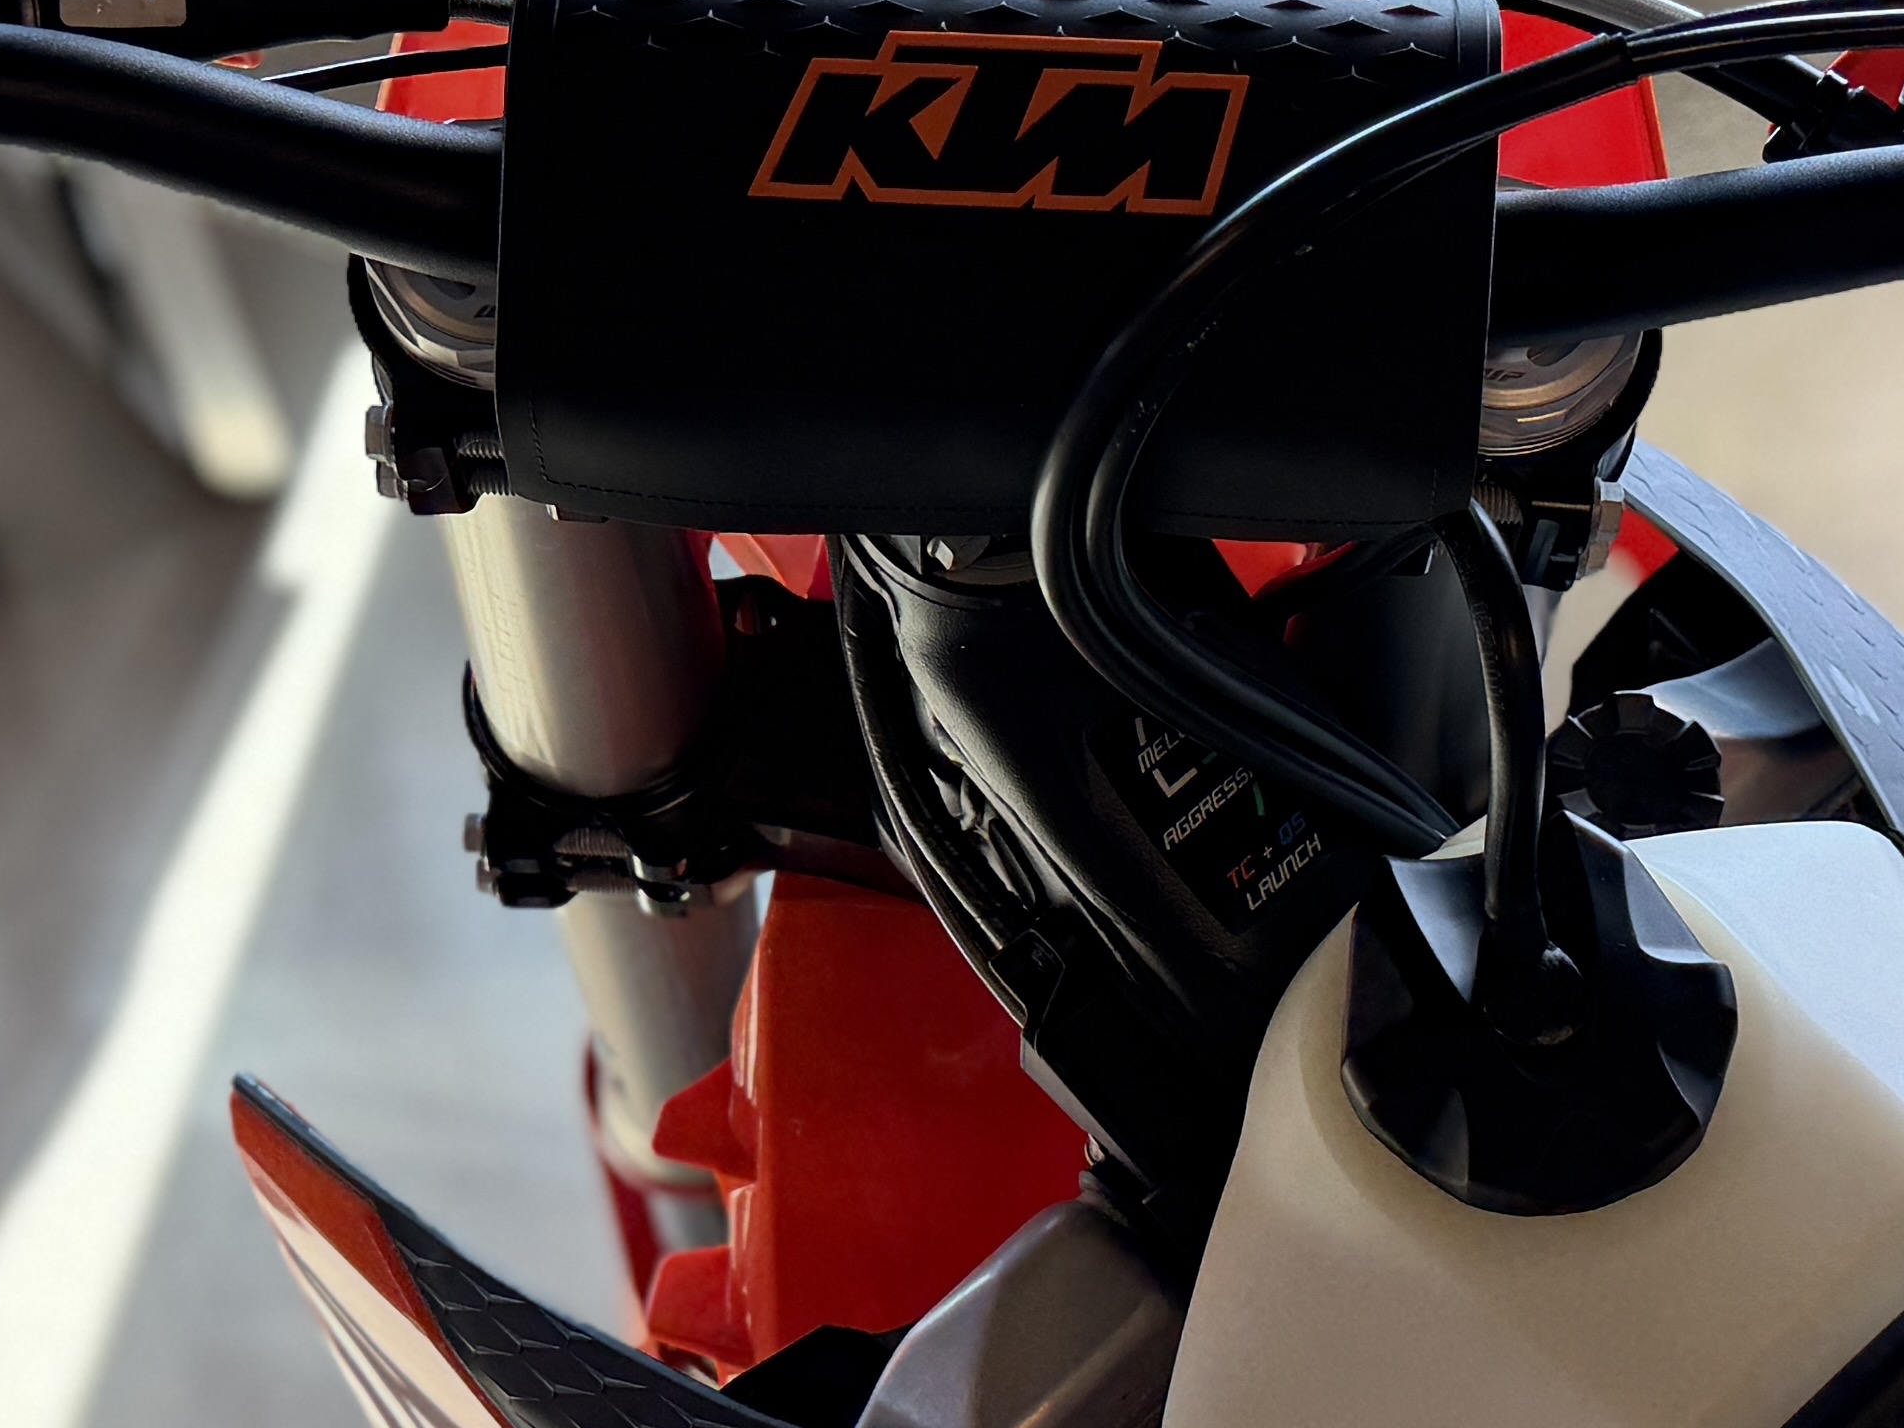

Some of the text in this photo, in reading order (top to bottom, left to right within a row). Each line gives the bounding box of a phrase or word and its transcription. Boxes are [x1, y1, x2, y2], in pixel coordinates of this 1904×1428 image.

[747, 29, 1250, 216] KTM
[1137, 732, 1185, 774] MEL
[1226, 854, 1259, 890] TC
[1277, 810, 1308, 846] QS
[1246, 832, 1323, 912] LAUNCH
